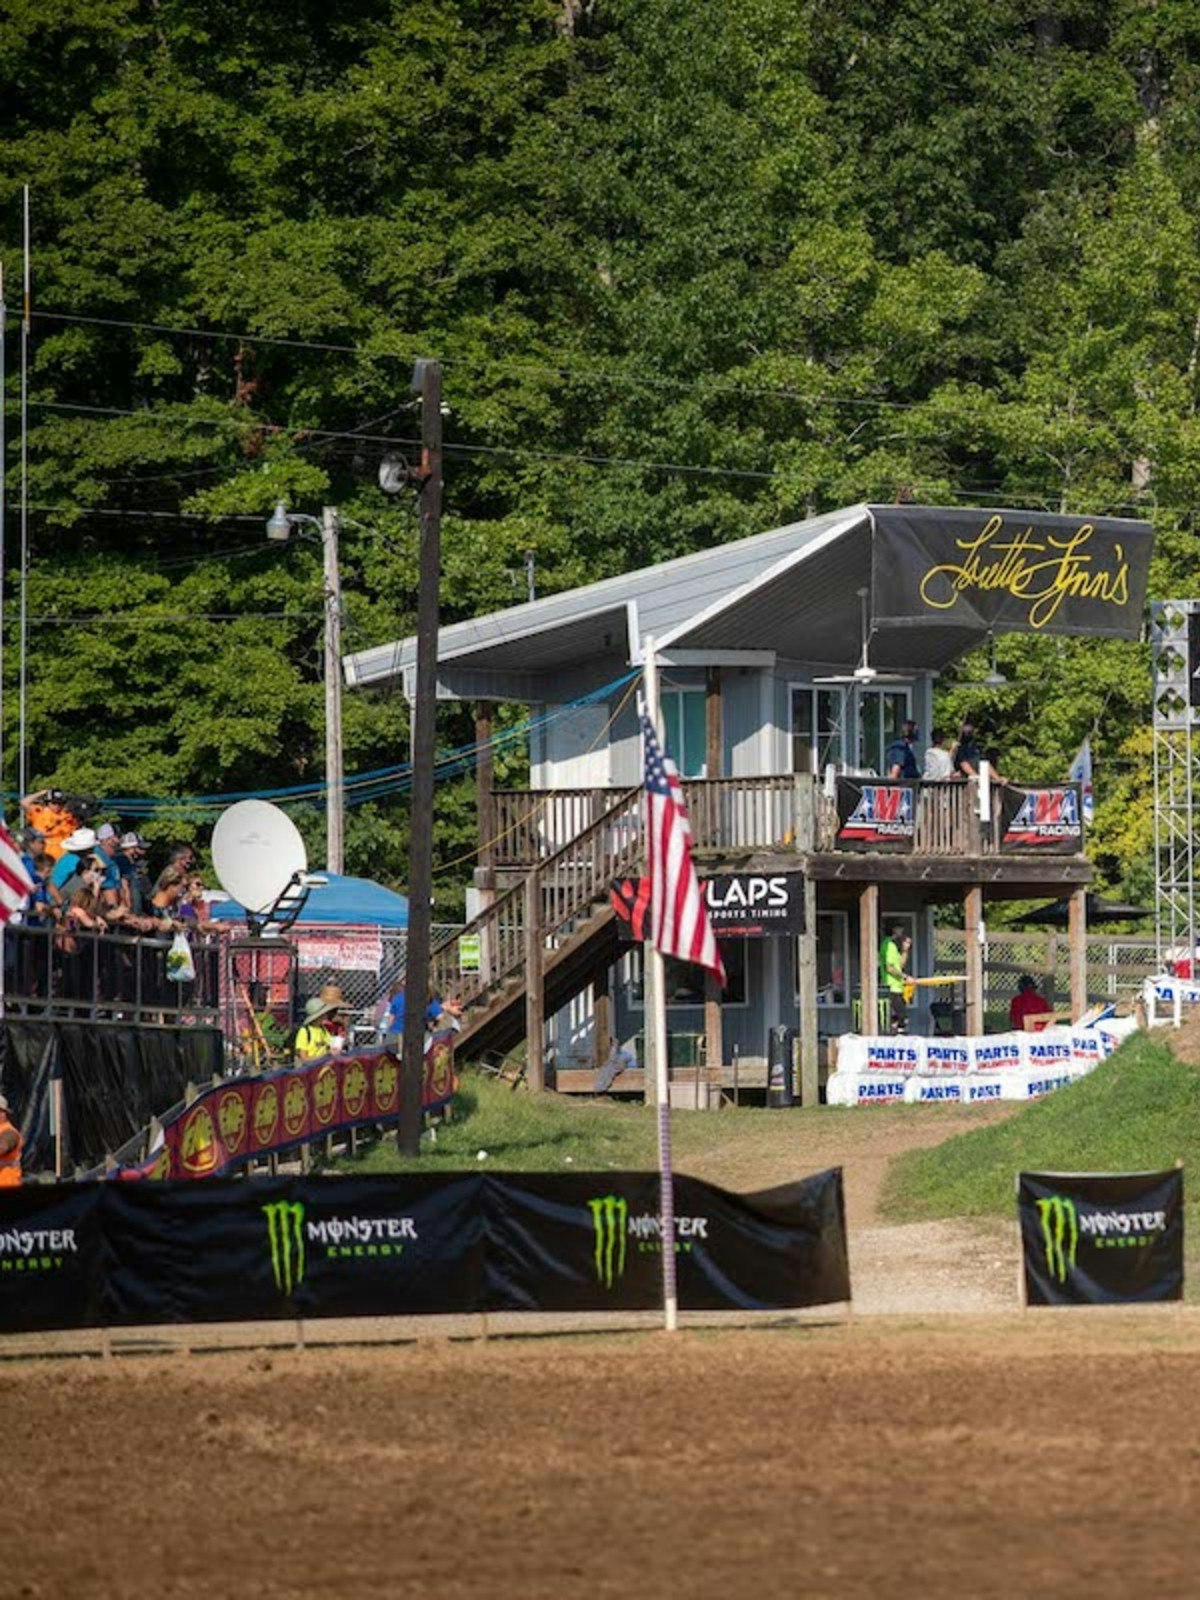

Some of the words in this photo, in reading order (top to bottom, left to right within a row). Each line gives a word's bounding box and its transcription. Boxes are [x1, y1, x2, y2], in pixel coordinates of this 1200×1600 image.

[848, 786, 914, 824] AMA
[1010, 789, 1081, 825] AMA
[878, 824, 914, 836] RACING
[1038, 825, 1080, 836] RACING
[751, 908, 787, 918] TIMING
[868, 1047, 917, 1061] PARTS
[927, 1047, 968, 1061] PARTS
[976, 1045, 1019, 1061] PARTS
[1029, 1045, 1071, 1057] PARTS
[858, 1083, 904, 1097] PARTS
[920, 1085, 961, 1099] PARTS
[1028, 1076, 1072, 1095] PARTS
[307, 1216, 418, 1244] MONSTER
[628, 1212, 708, 1239] MONER
[1080, 1211, 1166, 1236] MONSTER
[327, 1244, 403, 1257] ENERGY
